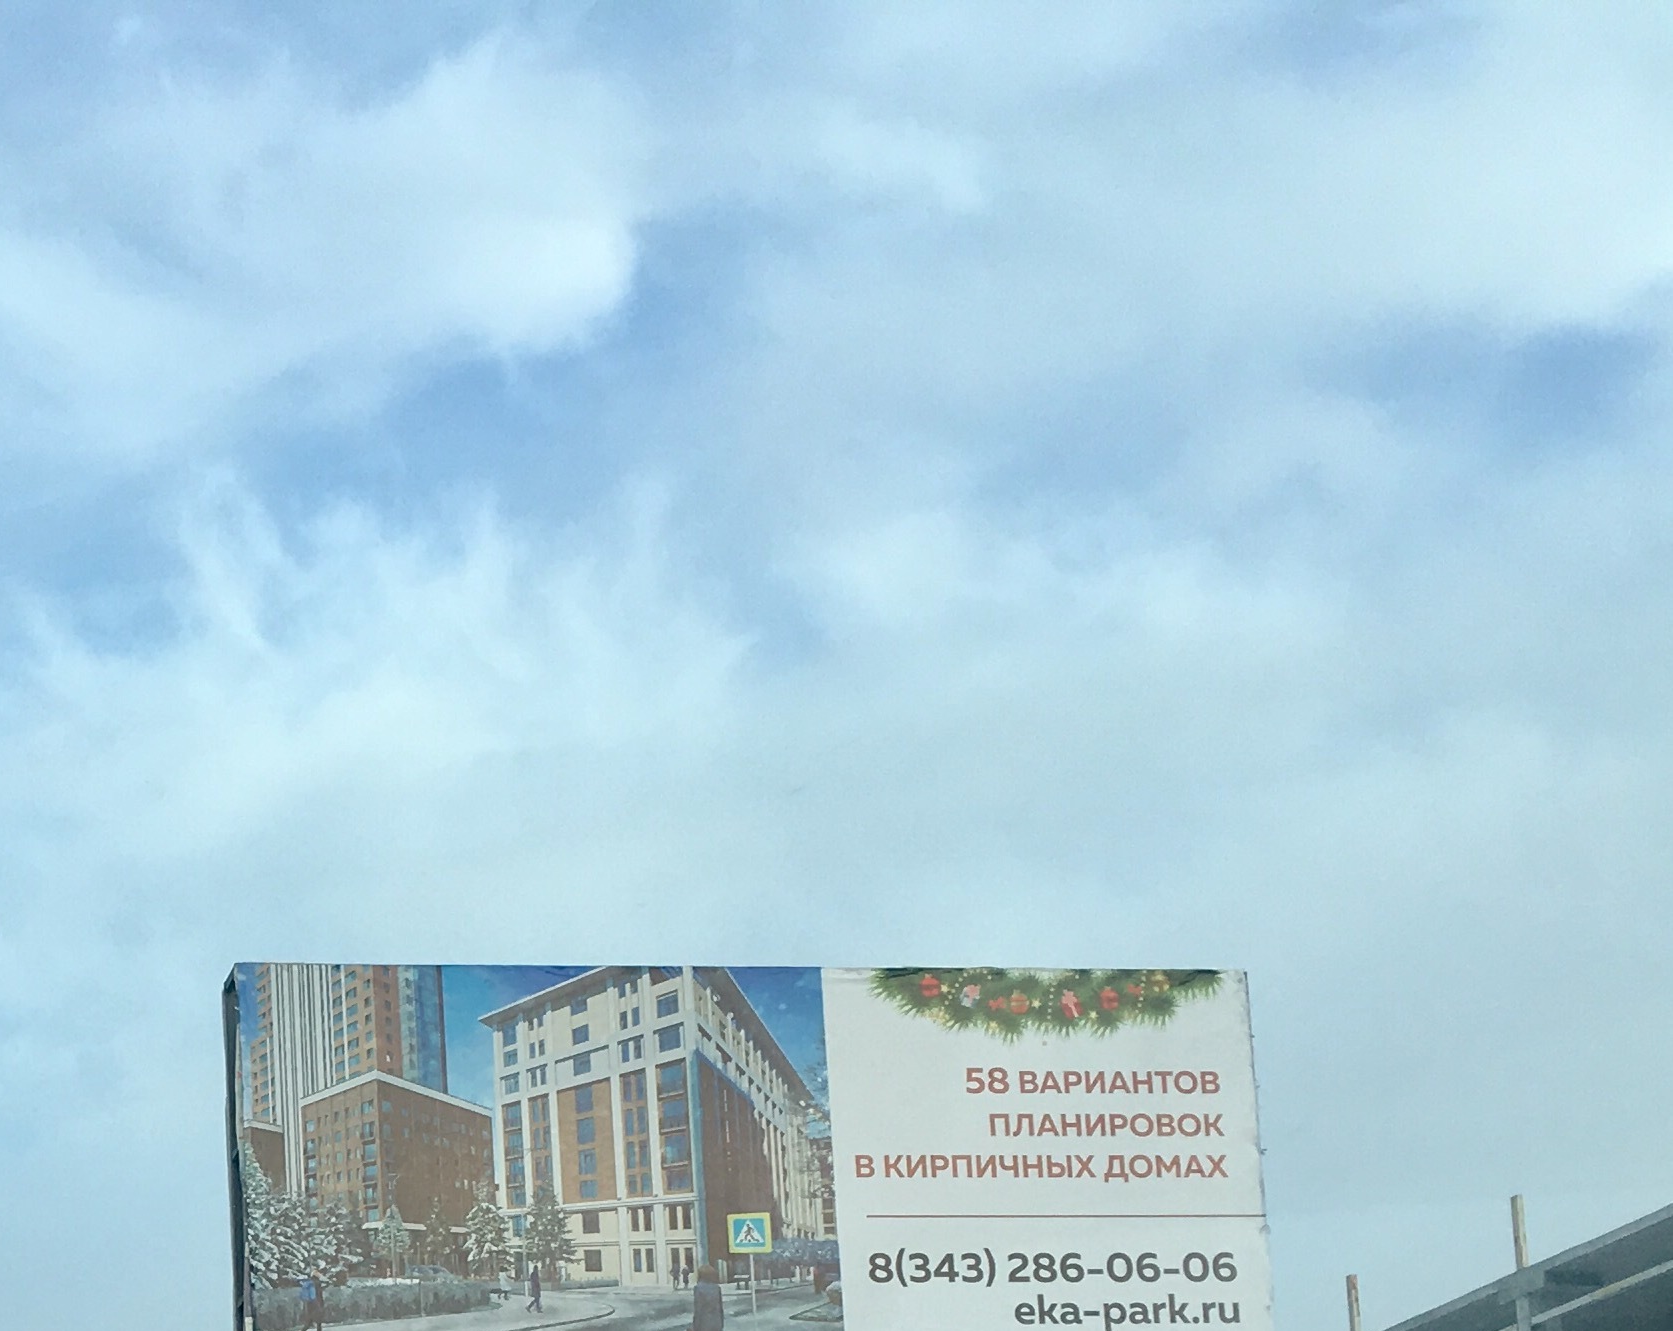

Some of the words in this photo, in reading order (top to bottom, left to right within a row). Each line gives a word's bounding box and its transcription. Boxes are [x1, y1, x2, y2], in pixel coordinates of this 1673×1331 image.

[966, 1067, 1009, 1094] 58
[1019, 1071, 1220, 1094] ВАРИАНТОВ
[989, 1113, 1225, 1137] ПЛАНИРОВОК
[855, 1155, 875, 1178] В
[884, 1155, 1096, 1178] КИРПИЧНЫХ
[1104, 1155, 1228, 1183] ДОМАХ
[869, 1248, 996, 1287] 8(343)
[1008, 1252, 1237, 1283] 286-06-06
